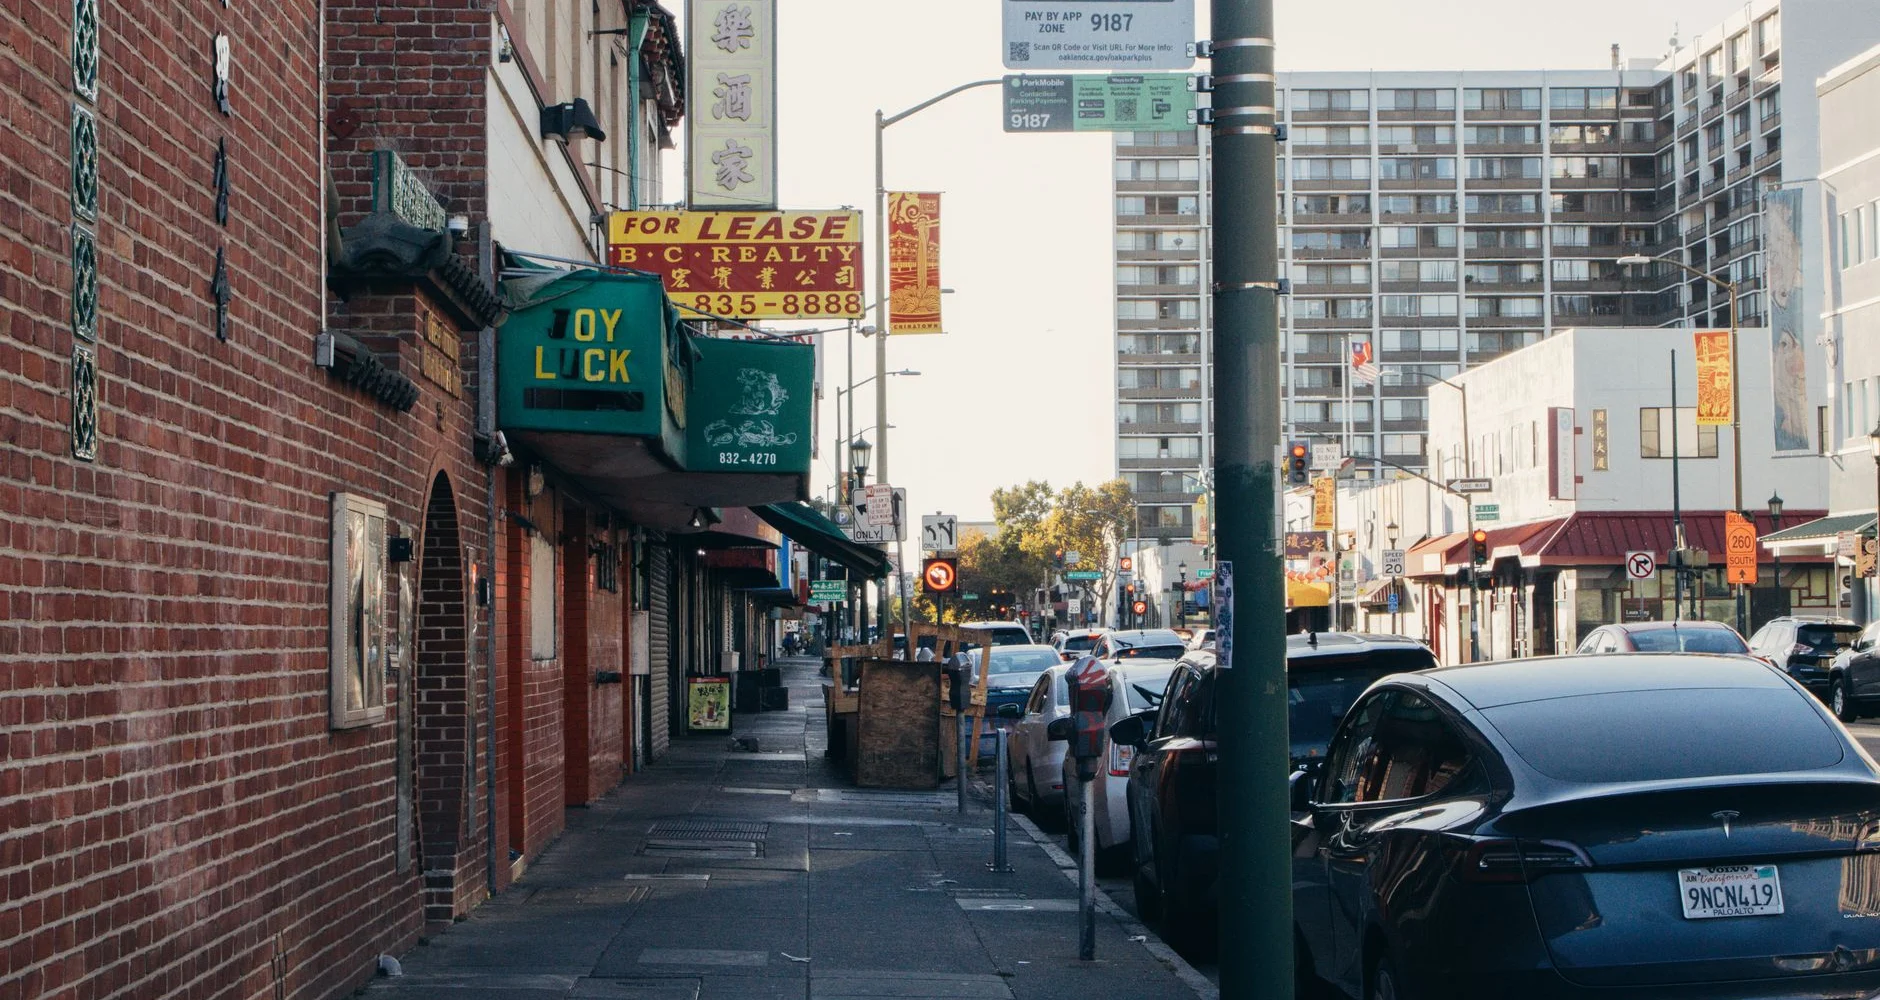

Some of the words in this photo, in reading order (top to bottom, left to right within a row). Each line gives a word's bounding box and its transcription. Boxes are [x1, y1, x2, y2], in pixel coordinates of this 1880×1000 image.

[1025, 11, 1043, 21] PAY
[1046, 11, 1059, 21] BY
[1062, 11, 1082, 21] APP
[1091, 13, 1133, 32] 9187
[1039, 23, 1066, 33] ZONE
[1033, 43, 1050, 51] Scan
[1052, 43, 1062, 52] QR
[1063, 43, 1081, 51] Code
[1092, 43, 1107, 51] Visit
[1109, 43, 1123, 51] URL
[1125, 43, 1136, 51] For
[1138, 43, 1155, 51] More
[1157, 43, 1173, 51] Info:
[1058, 53, 1152, 62] oaklandca.gov/oakparkplus
[1022, 79, 1065, 87] ParkMobile
[1011, 113, 1050, 128] 9187
[624, 217, 680, 234] FOR
[697, 215, 850, 240] LEASE
[535, 345, 631, 383] LUCK
[719, 452, 777, 465] 832-4270
[855, 530, 880, 540] ONLY
[1732, 535, 1751, 549] 260
[1729, 556, 1754, 565] SOUTH
[1385, 563, 1403, 574] 20
[1707, 865, 1749, 874] VOLVO
[1685, 875, 1697, 883] JUN
[1700, 873, 1758, 885] California
[1688, 883, 1773, 910] 9NCN419
[1713, 908, 1734, 916] PALO
[1734, 907, 1754, 915] ALTO
